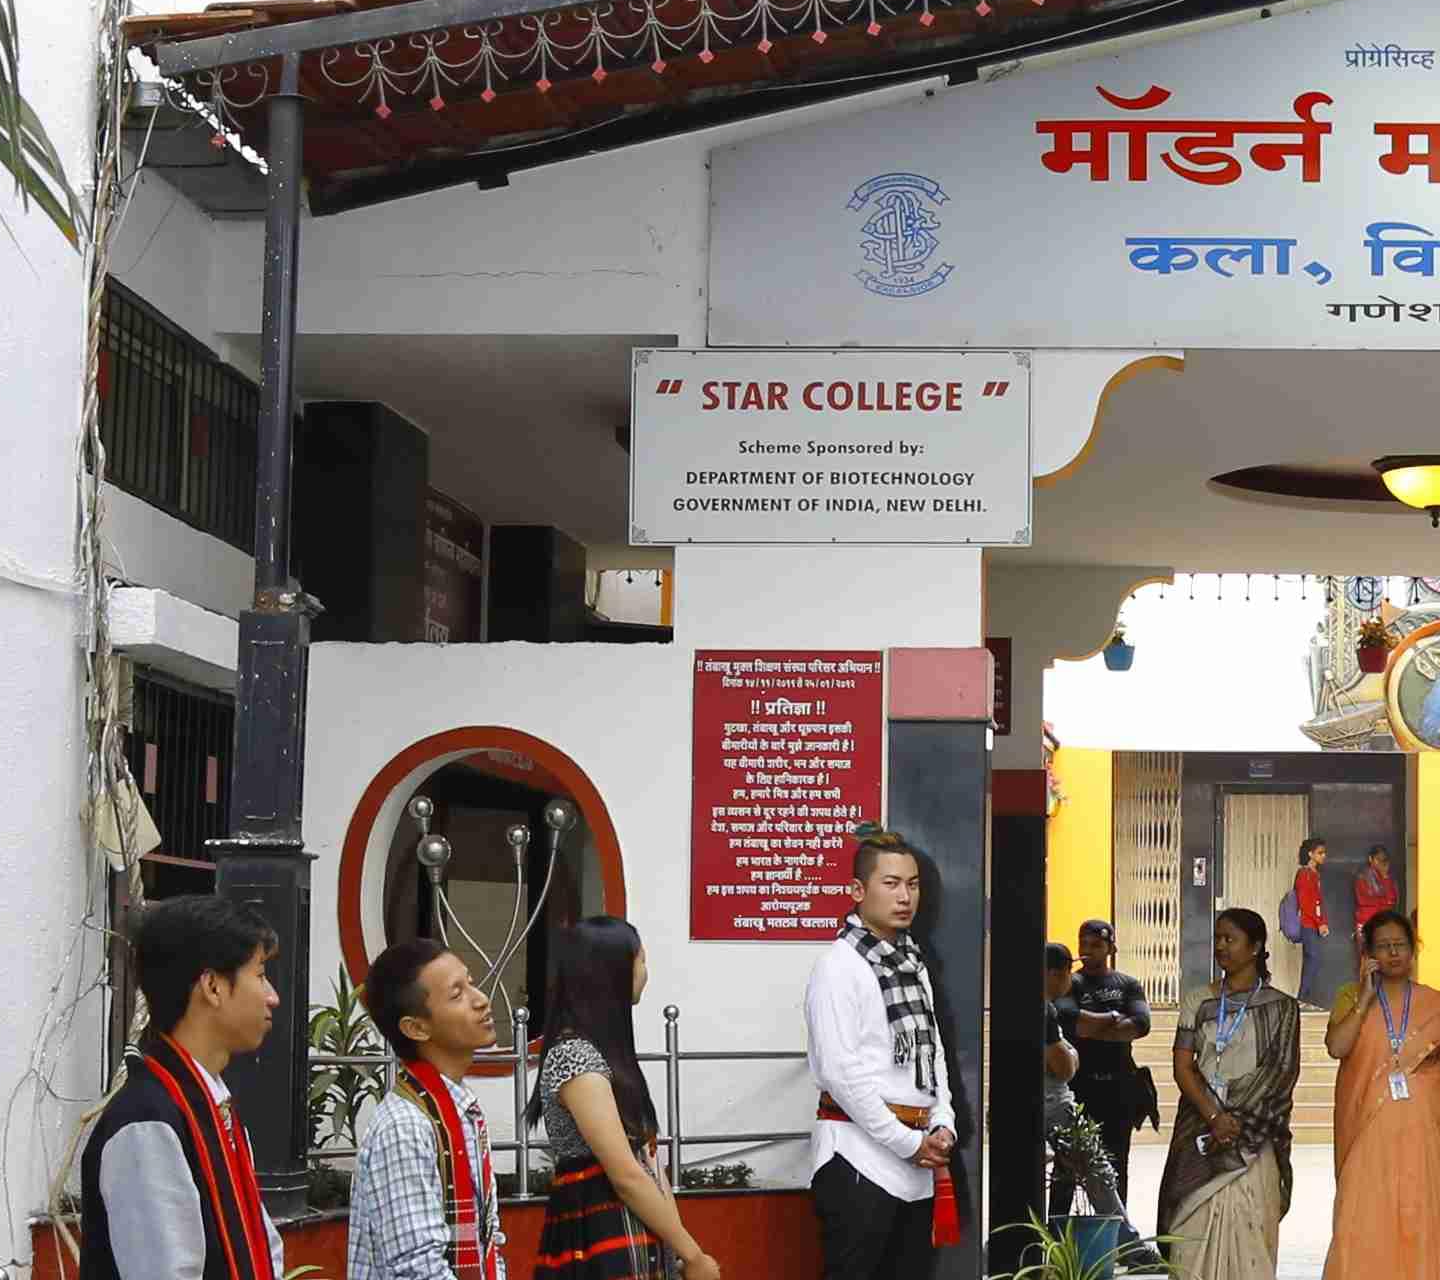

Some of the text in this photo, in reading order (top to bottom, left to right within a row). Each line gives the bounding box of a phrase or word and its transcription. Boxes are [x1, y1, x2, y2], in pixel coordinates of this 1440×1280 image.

[1036, 85, 1334, 186] मॉडर्न
[1125, 237, 1333, 286] कला,
[701, 381, 963, 412] STAR COLLEGE
[739, 439, 924, 458] Scheme Sponsored by:
[686, 470, 976, 487] DEPARTMENT OF BIOTECHNOLOGY
[673, 497, 987, 516] GOVERNMENT OF INDIA, NEW DELHI.
[764, 697, 813, 716] प्रतिज्ञा
